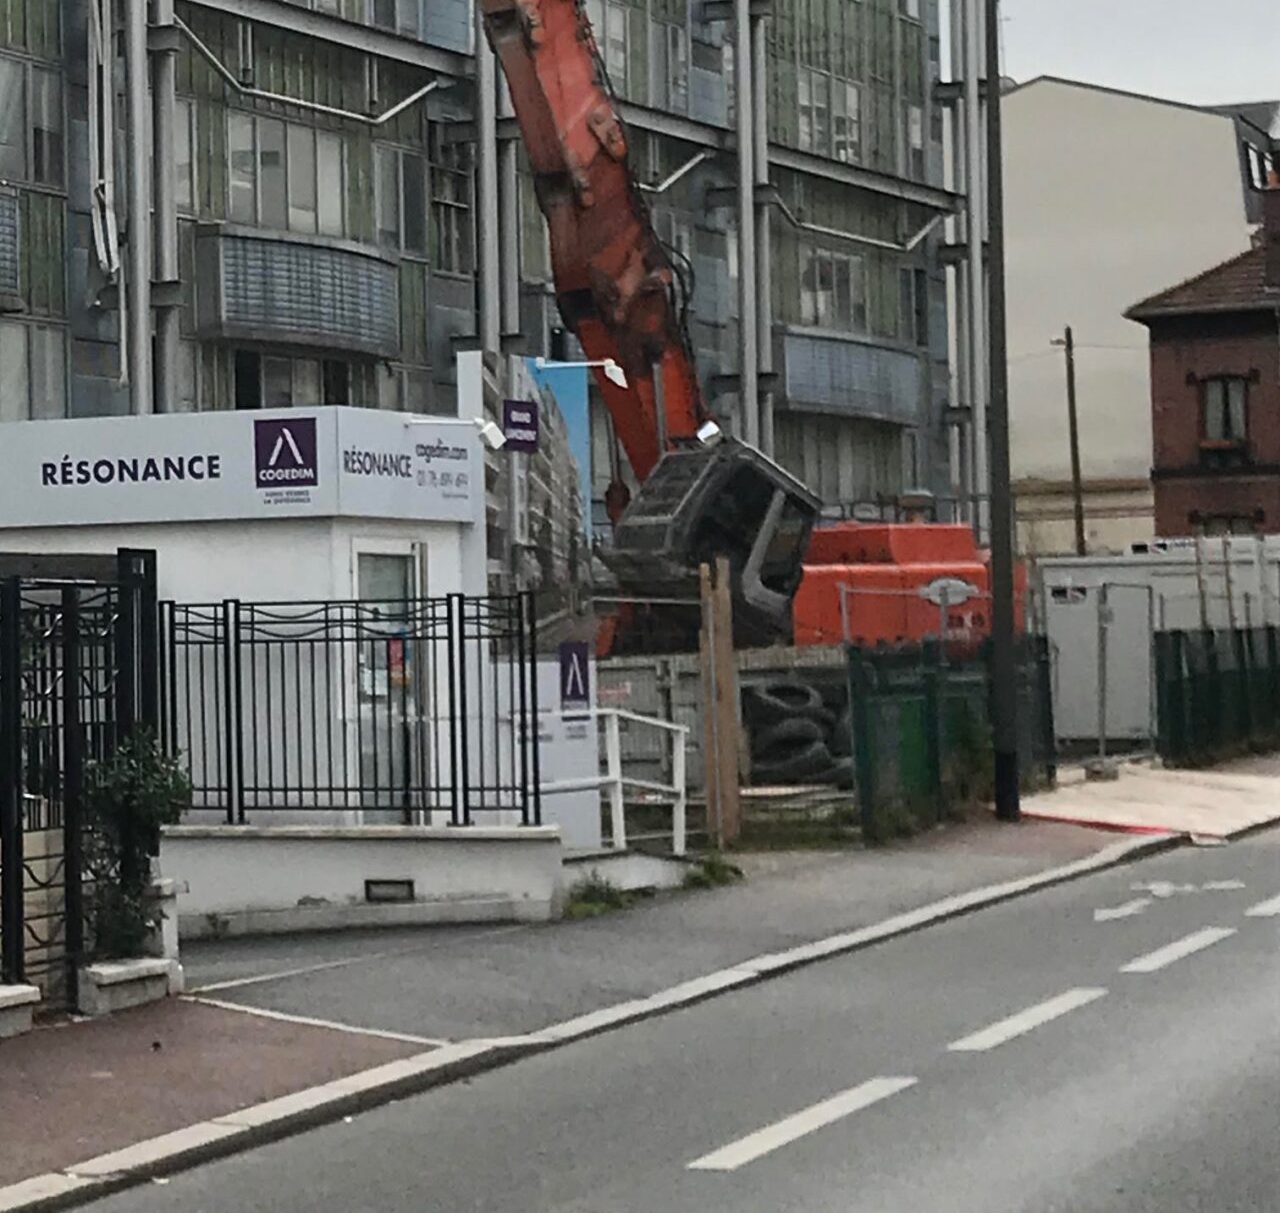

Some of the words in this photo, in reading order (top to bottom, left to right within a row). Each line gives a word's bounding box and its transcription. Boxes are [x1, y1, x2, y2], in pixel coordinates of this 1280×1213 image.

[42, 454, 221, 486] RÉSONANCE
[259, 468, 314, 481] COGEDIM
[343, 445, 413, 478] RÉSONANCE
